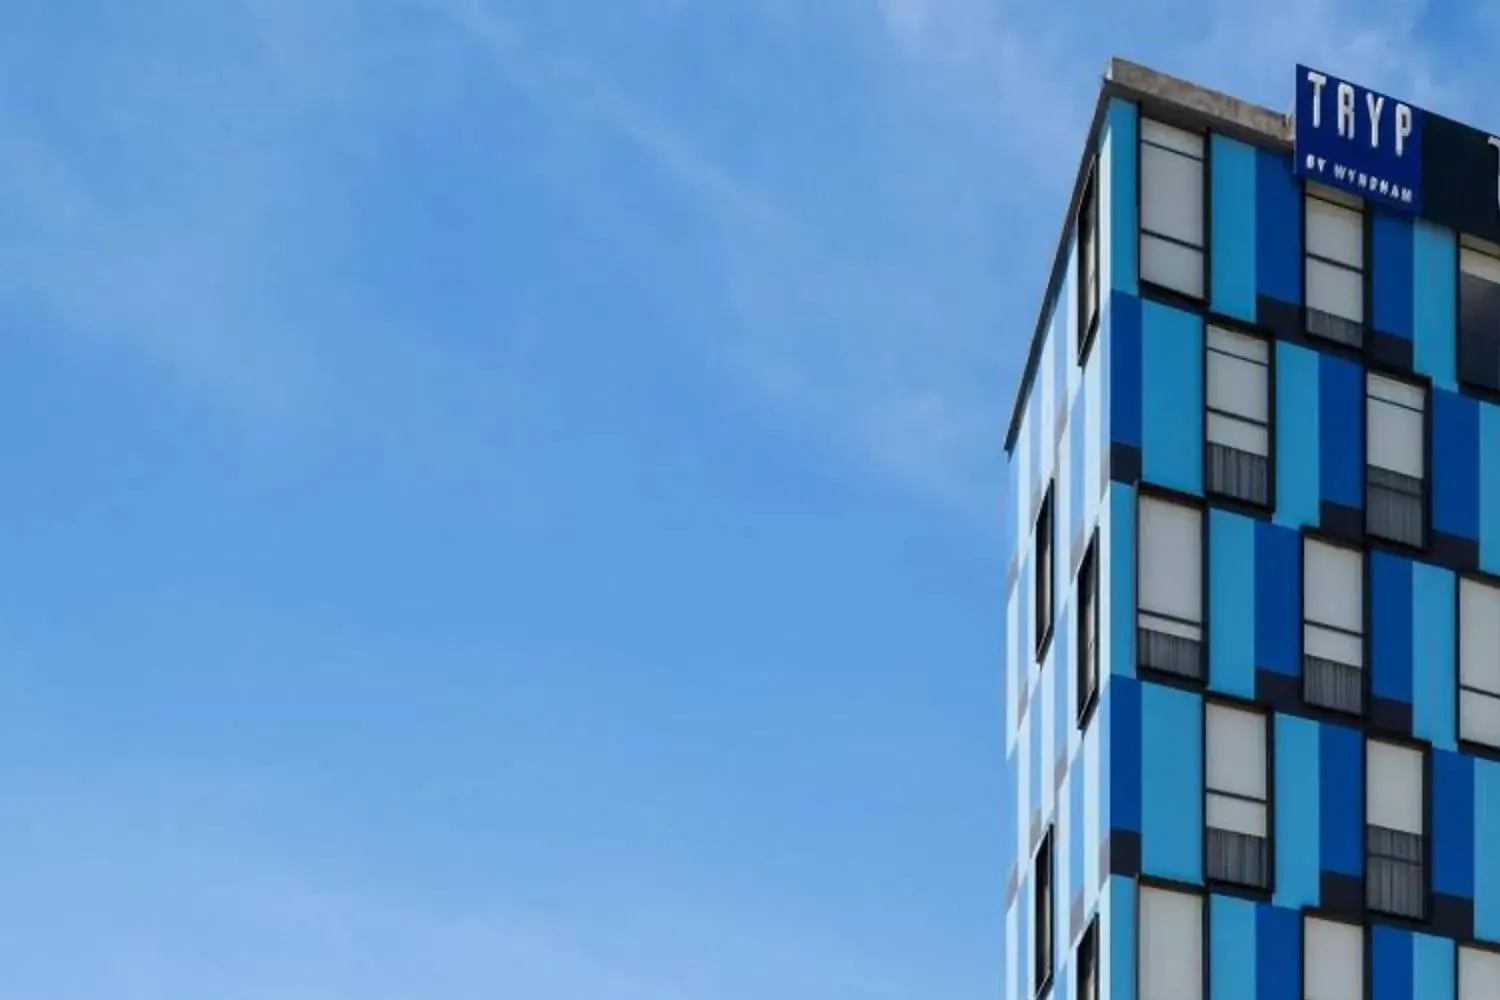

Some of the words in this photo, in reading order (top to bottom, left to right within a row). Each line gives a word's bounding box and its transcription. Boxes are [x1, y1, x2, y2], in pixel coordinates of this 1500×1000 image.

[1307, 71, 1412, 157] TRYP
[1306, 153, 1326, 172] BY
[1333, 163, 1412, 203] WYNDHAM
